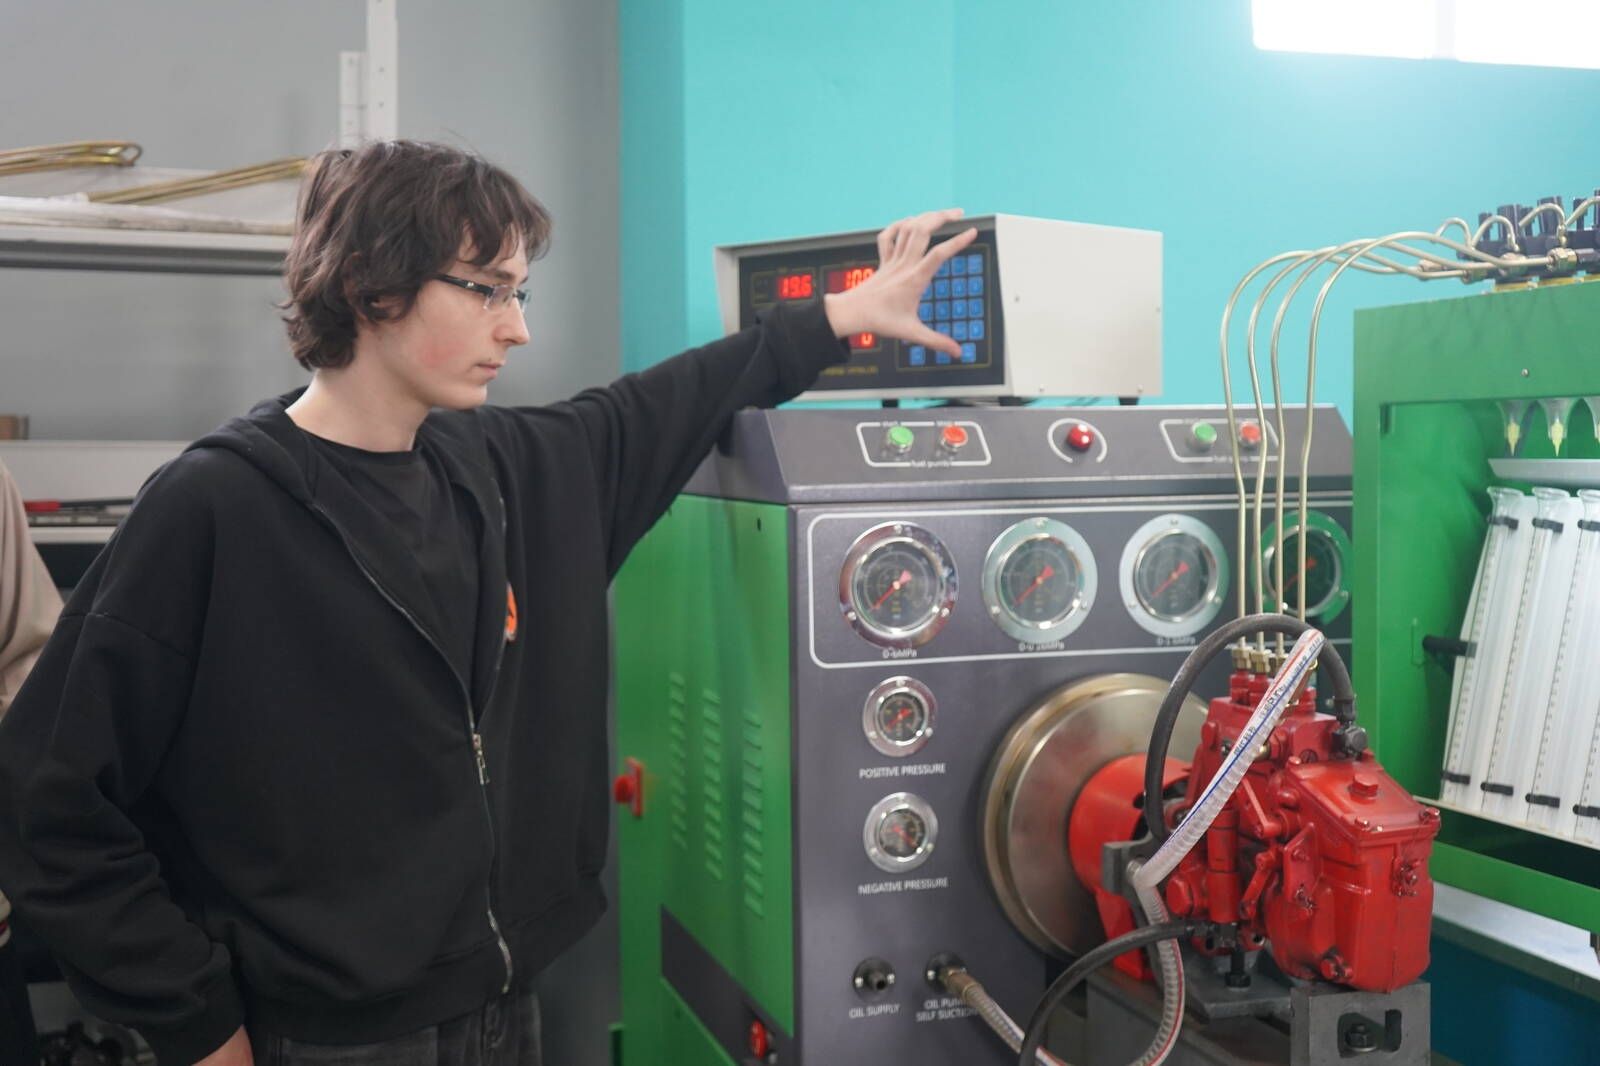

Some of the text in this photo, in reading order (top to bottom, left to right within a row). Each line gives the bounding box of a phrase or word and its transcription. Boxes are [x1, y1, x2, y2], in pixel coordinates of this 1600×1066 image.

[859, 763, 946, 779] POSITIVE PRESSURE
[858, 877, 948, 895] NEGATIVE PRESSURE
